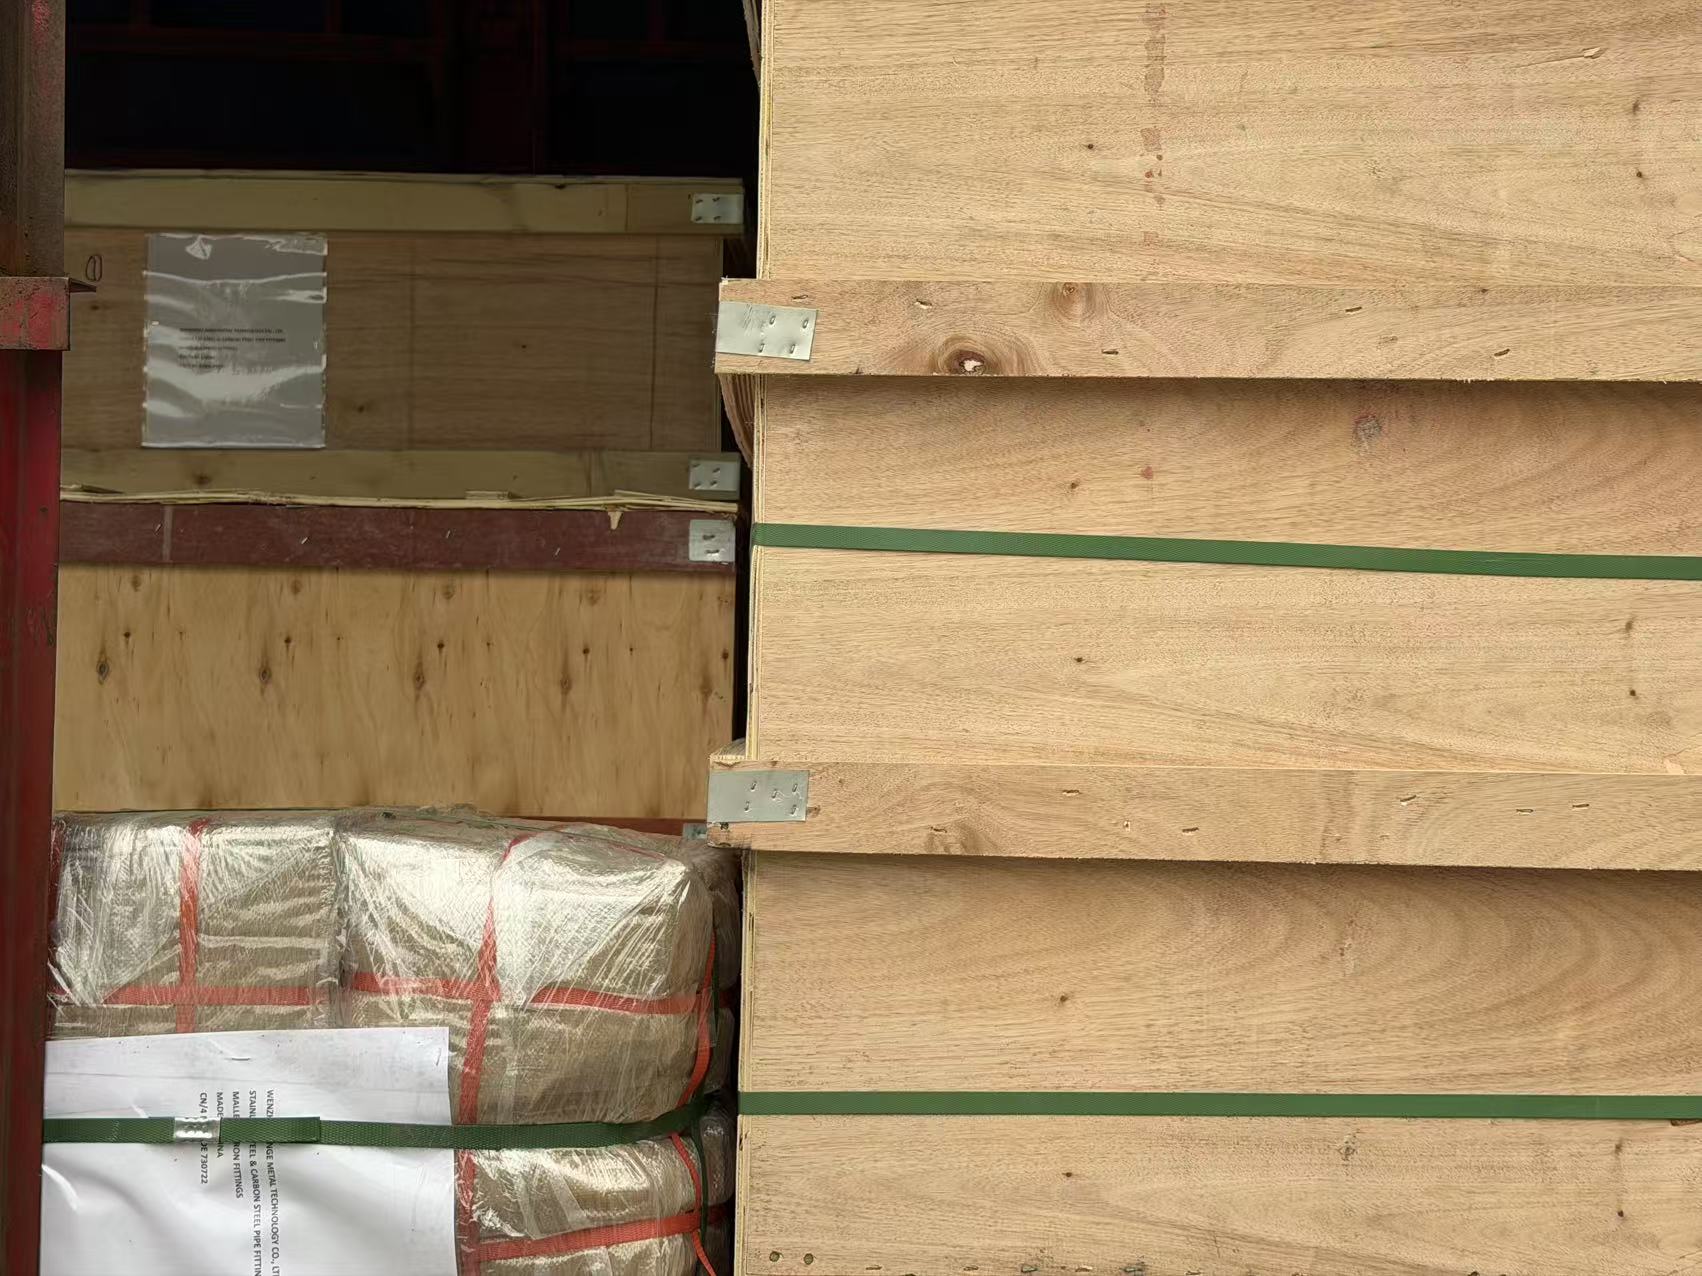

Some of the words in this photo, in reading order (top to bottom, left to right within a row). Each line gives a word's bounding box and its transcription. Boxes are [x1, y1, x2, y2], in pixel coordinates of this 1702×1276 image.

[199, 1092, 208, 1114] CN/4
[232, 1091, 240, 1119] MALLE
[200, 1154, 208, 1184] 730722
[234, 1163, 243, 1199] FITTINGS
[267, 1162, 276, 1187] METAL
[250, 1168, 260, 1202] CARBON
[270, 1188, 279, 1245] TECHNOLOGY
[254, 1230, 262, 1248] PIPE
[272, 1266, 280, 1276] LT
